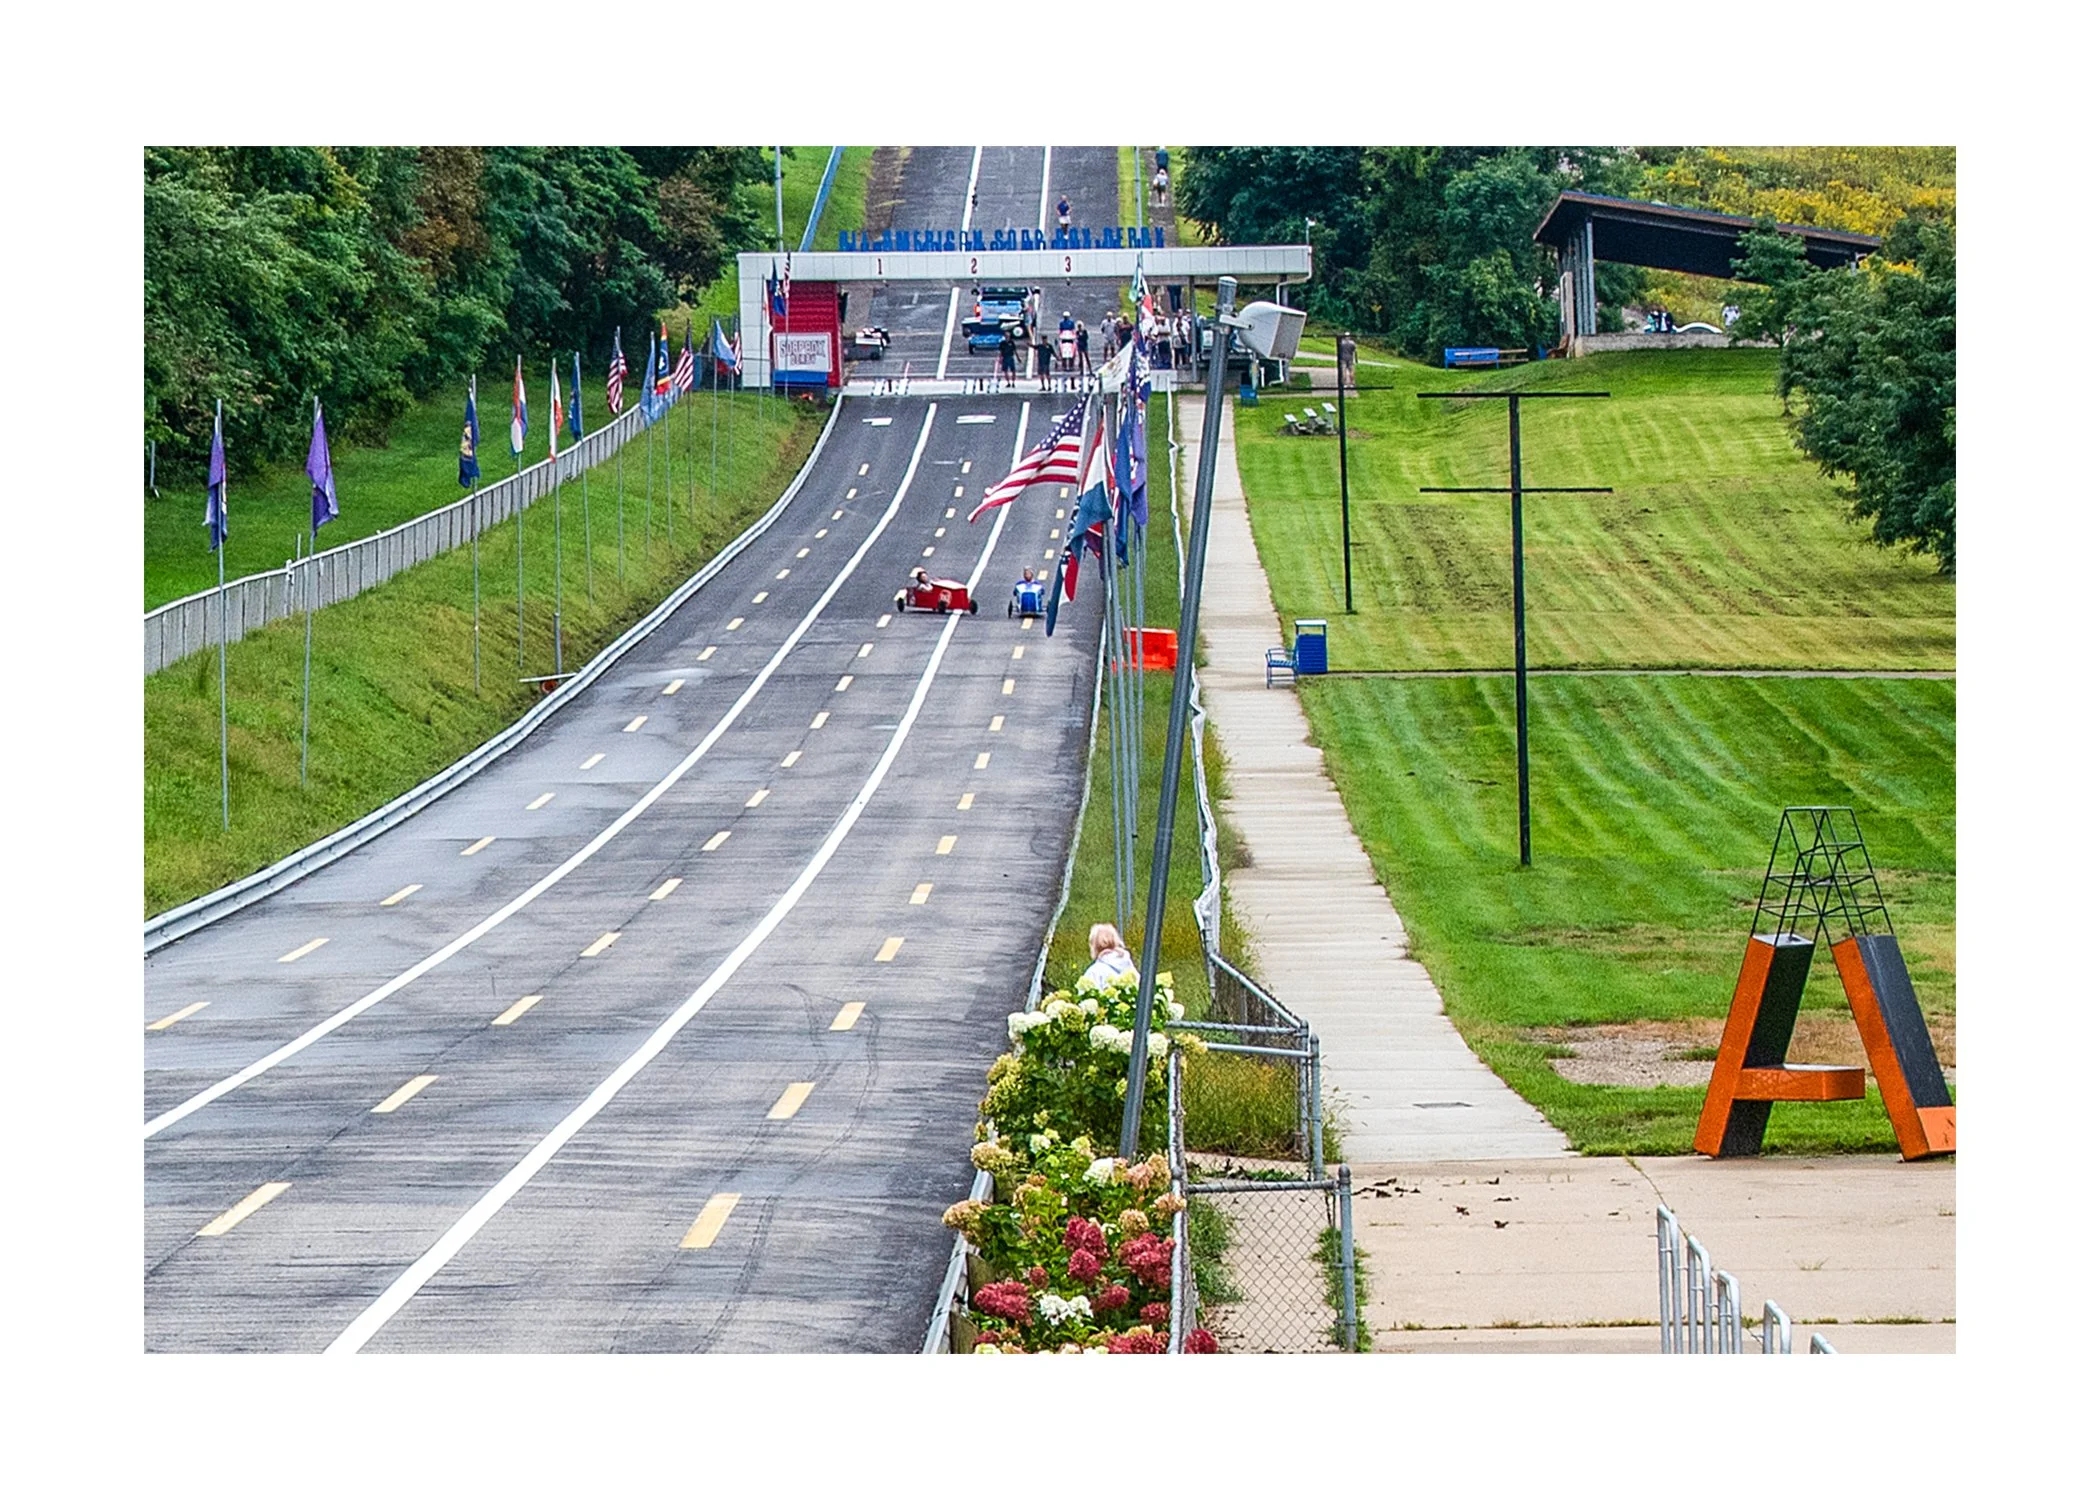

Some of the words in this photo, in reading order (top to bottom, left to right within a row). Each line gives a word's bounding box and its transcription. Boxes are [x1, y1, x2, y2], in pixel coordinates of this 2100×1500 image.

[877, 258, 883, 275] 1
[970, 257, 978, 274] 2
[1064, 256, 1072, 272] 3
